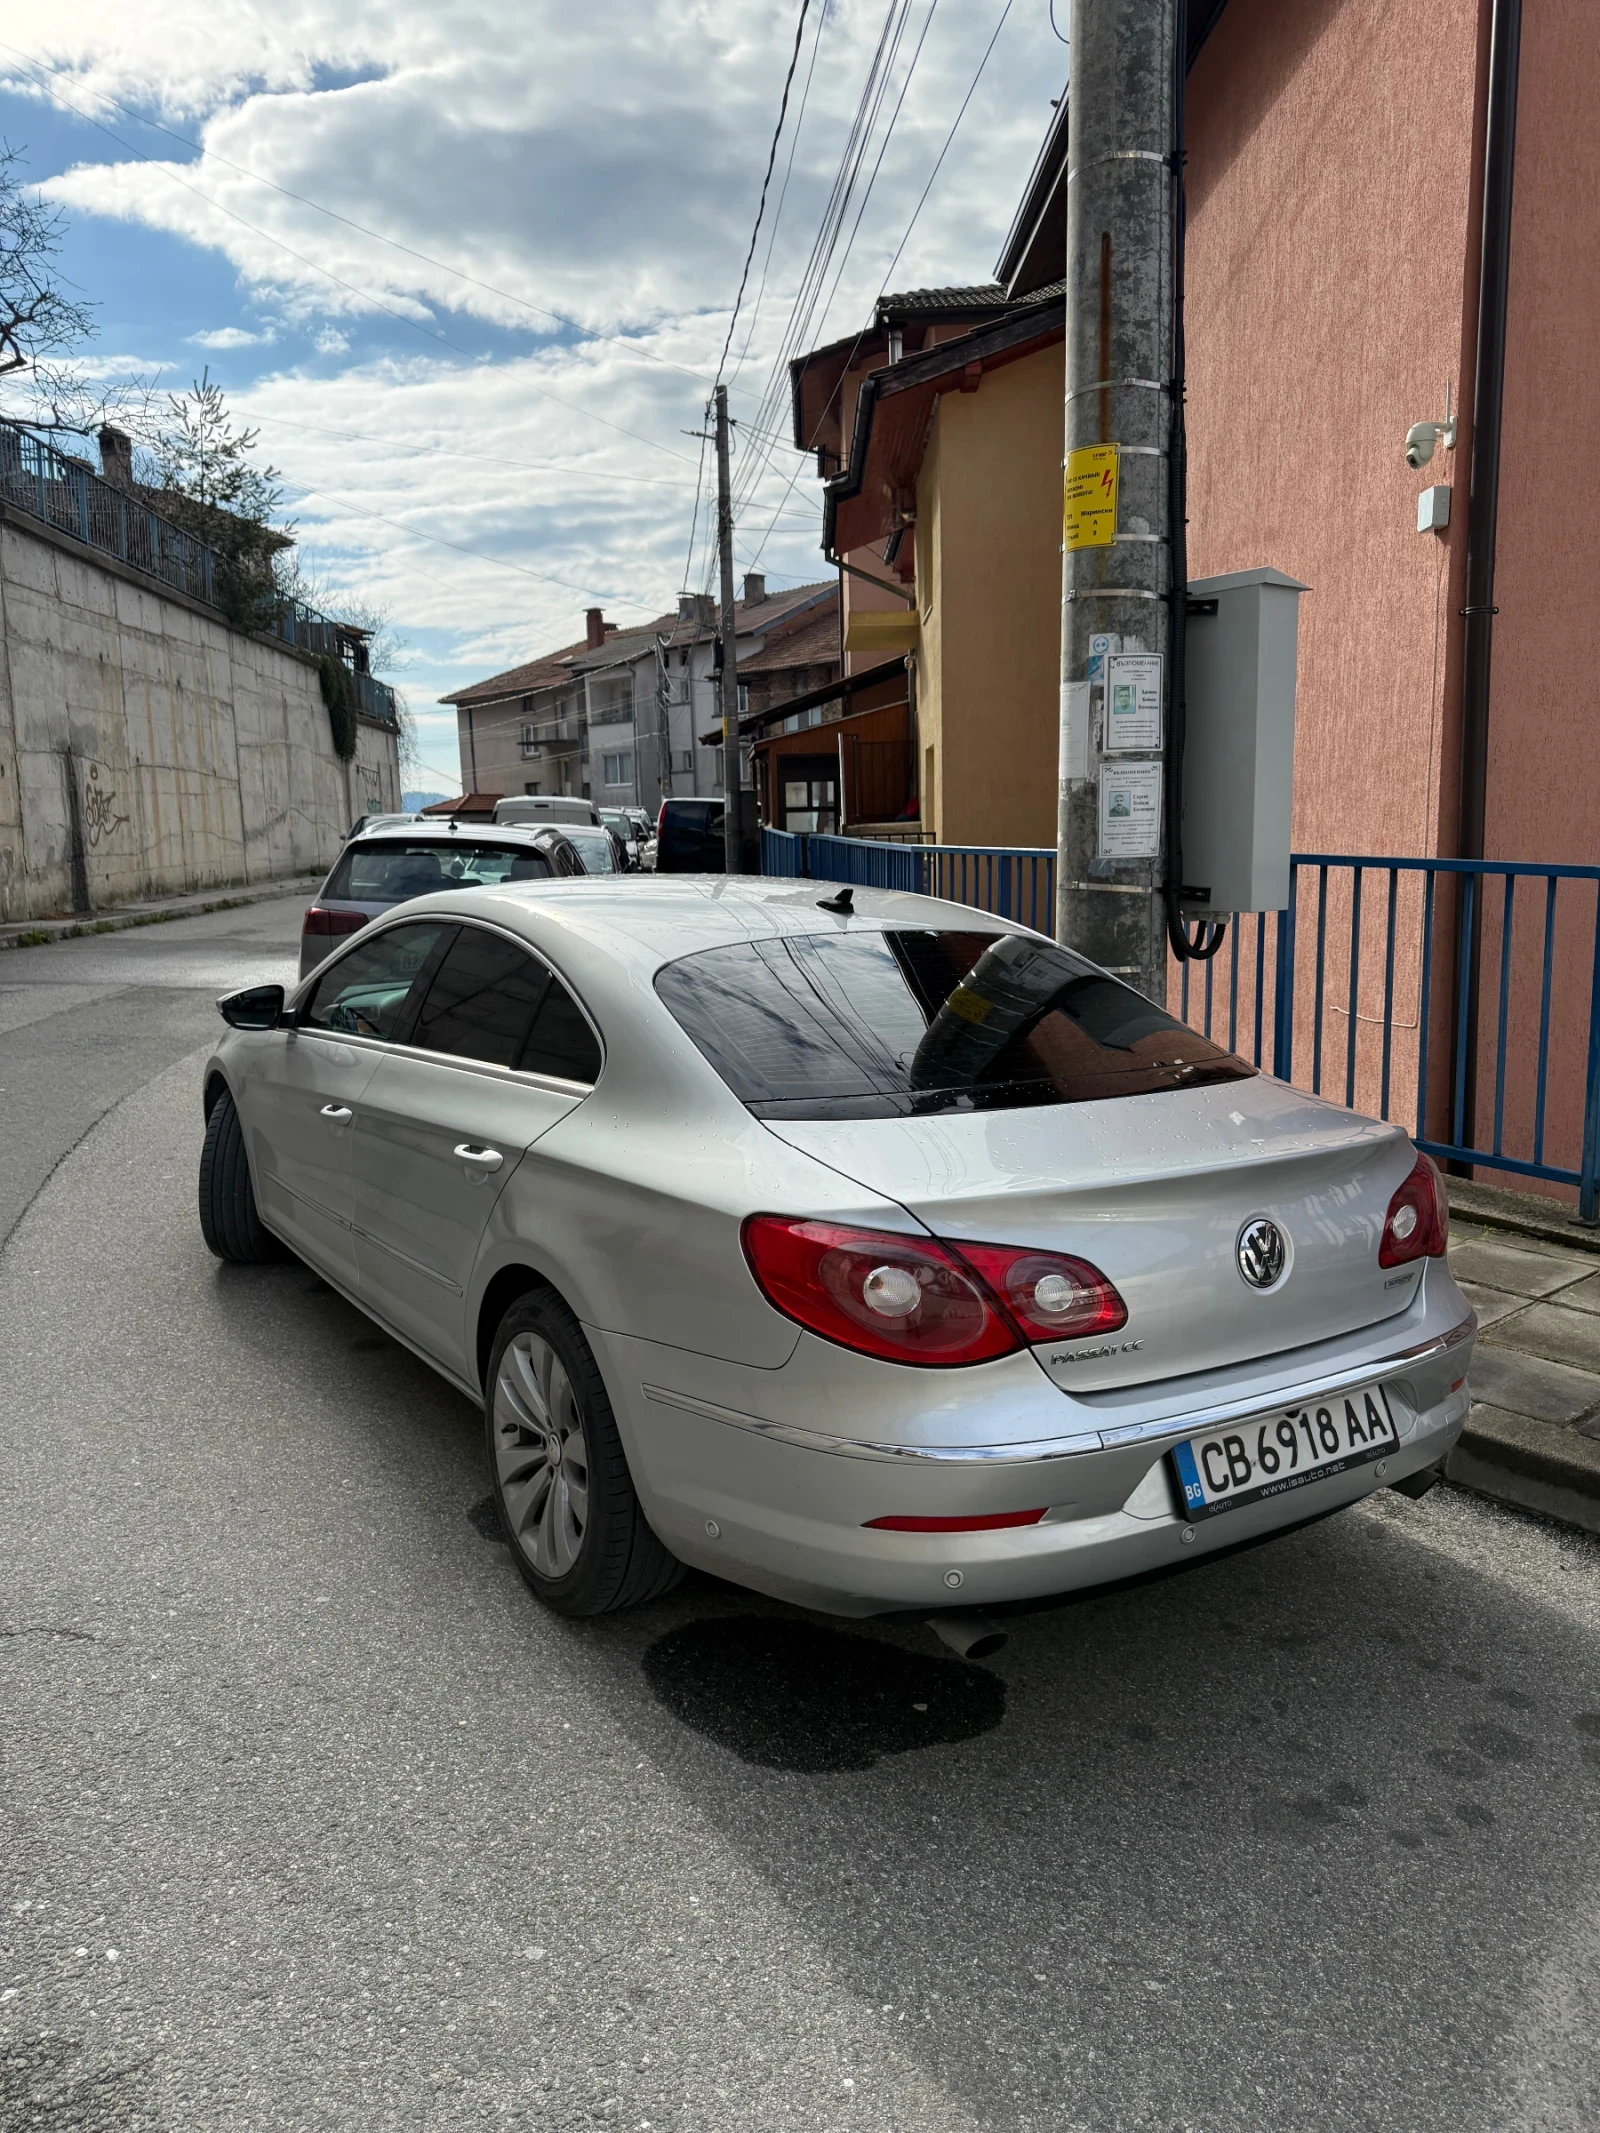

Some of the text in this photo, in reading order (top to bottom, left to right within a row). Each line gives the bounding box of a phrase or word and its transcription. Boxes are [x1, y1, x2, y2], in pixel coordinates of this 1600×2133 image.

[1081, 508, 1113, 516] Марински
[1051, 1339, 1144, 1365] PASSAT CC
[1260, 1461, 1345, 1496] www.isauto.net
[1185, 1483, 1202, 1500] BG
